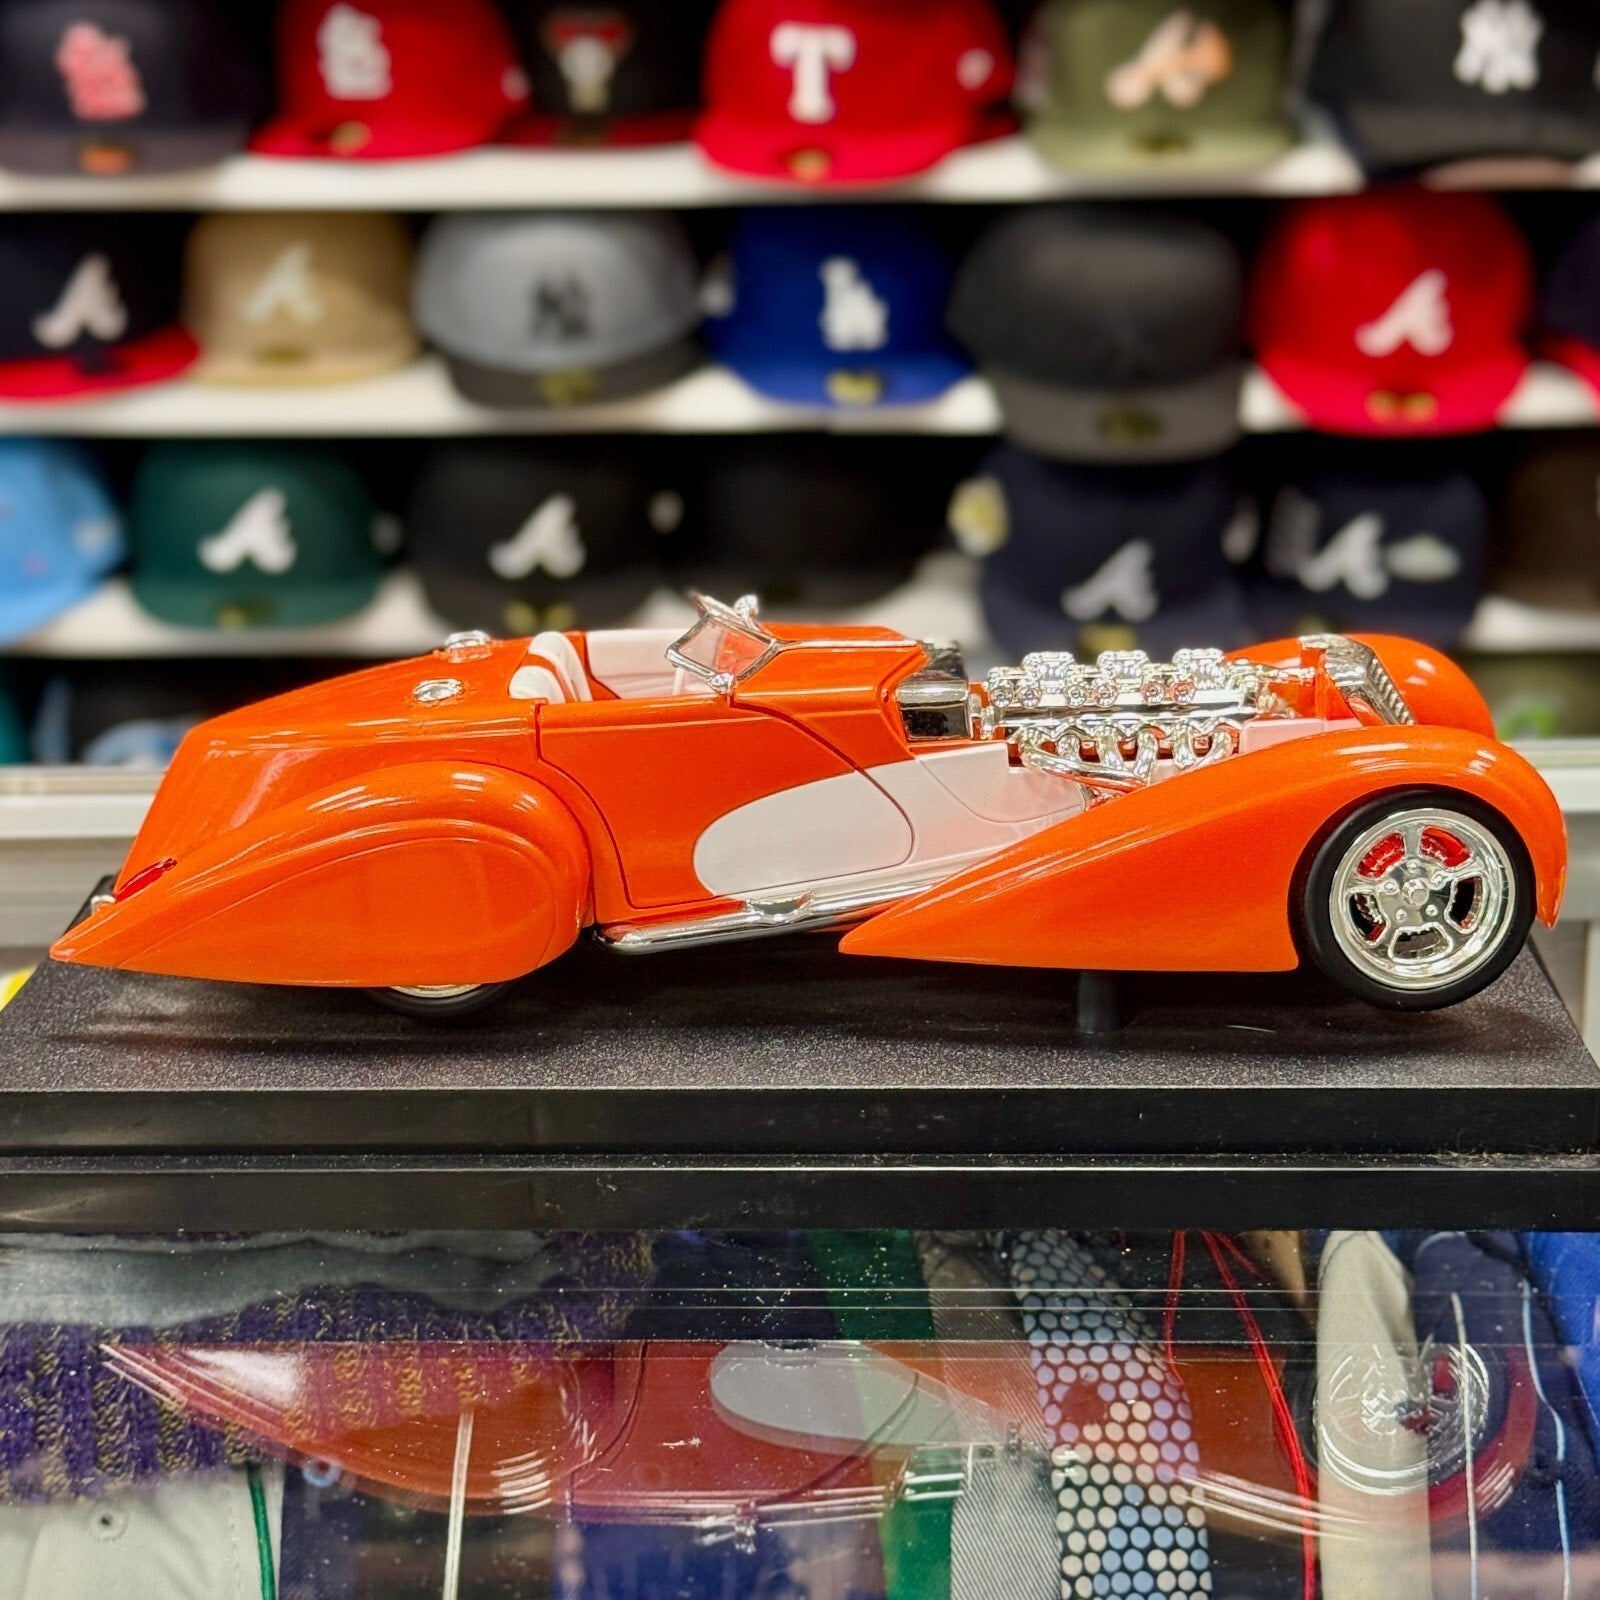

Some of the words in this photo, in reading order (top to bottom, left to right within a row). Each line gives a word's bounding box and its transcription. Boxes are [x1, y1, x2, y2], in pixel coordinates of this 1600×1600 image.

[769, 20, 857, 125] T
[1355, 269, 1453, 357] A
[200, 488, 296, 573] A
[489, 495, 585, 579] A
